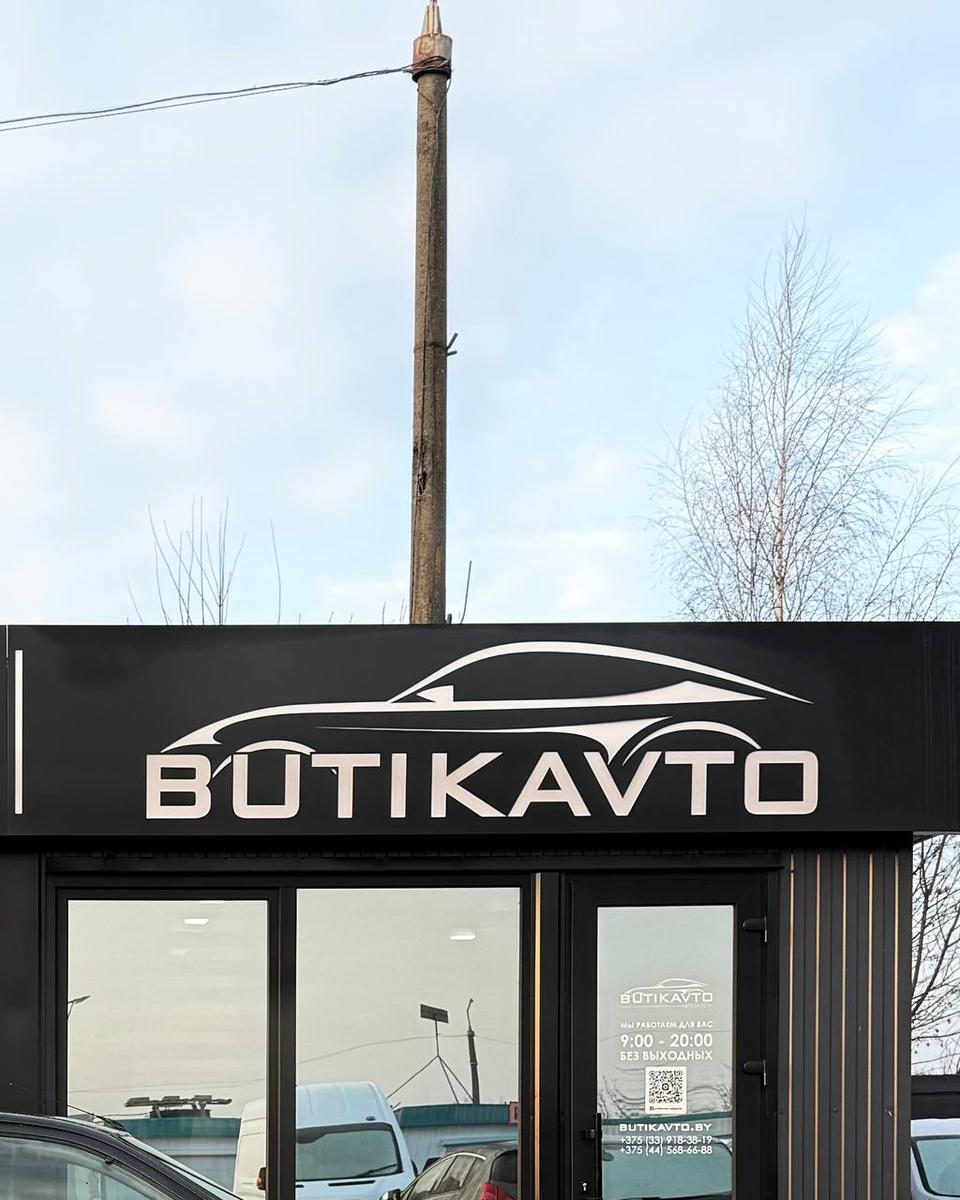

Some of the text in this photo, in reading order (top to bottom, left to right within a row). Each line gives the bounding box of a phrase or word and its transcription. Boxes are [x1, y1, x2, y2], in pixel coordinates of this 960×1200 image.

[145, 750, 819, 820] BUTIKAVTO
[620, 992, 713, 1004] BUTIKAVTO
[636, 1021, 677, 1029] РАБОТАЕМ
[620, 1034, 654, 1048] 9:00
[670, 1033, 713, 1047] 20:00
[620, 1050, 713, 1061] БЕЗ ВЫХОДНЫХ
[619, 1123, 712, 1132] BUTIKAVTO.BY
[620, 1135, 713, 1146] +375 (33) 918-38-19
[620, 1145, 713, 1156] +375 (44) 568-66-88
